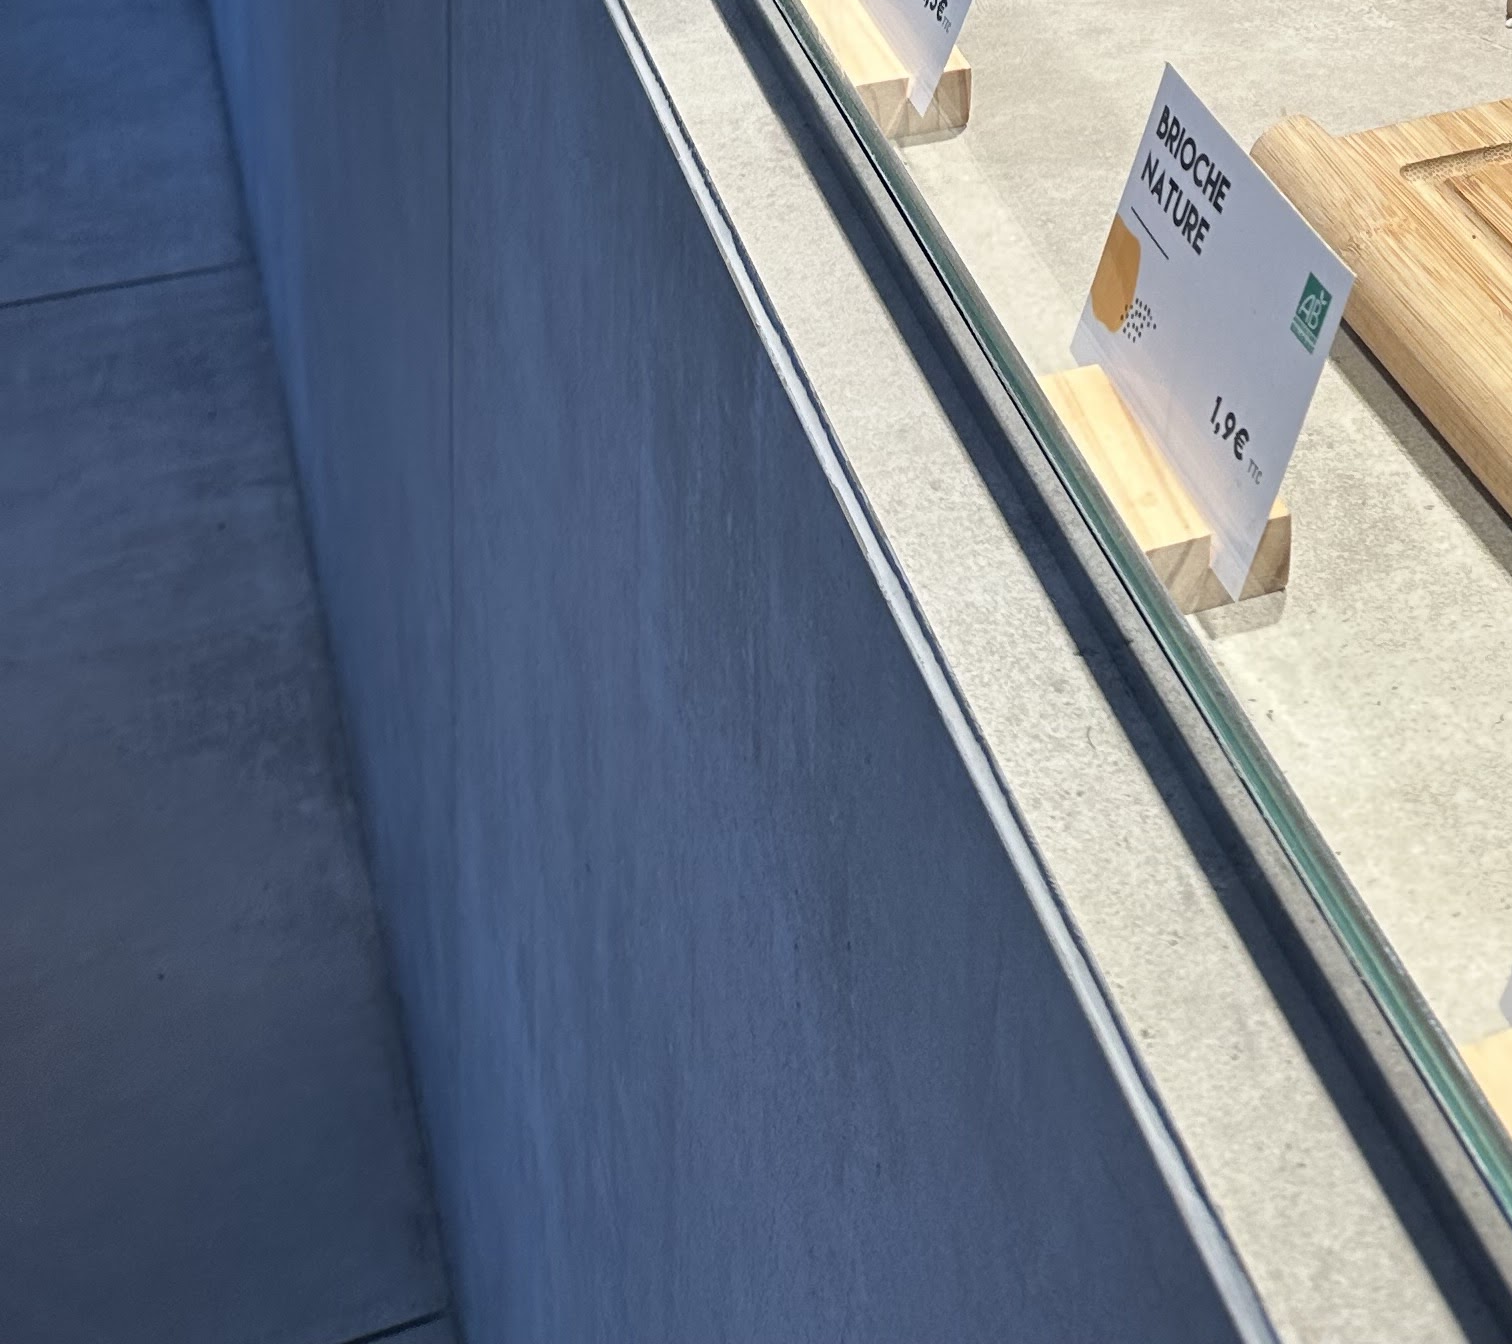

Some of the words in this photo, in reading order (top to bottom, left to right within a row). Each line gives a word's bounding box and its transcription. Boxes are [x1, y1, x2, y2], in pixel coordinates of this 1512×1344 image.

[1140, 149, 1211, 256] NATURE
[1155, 104, 1232, 215] BRIOCHE
[1210, 395, 1250, 461] 1,9€
[1246, 458, 1264, 486] TTC
